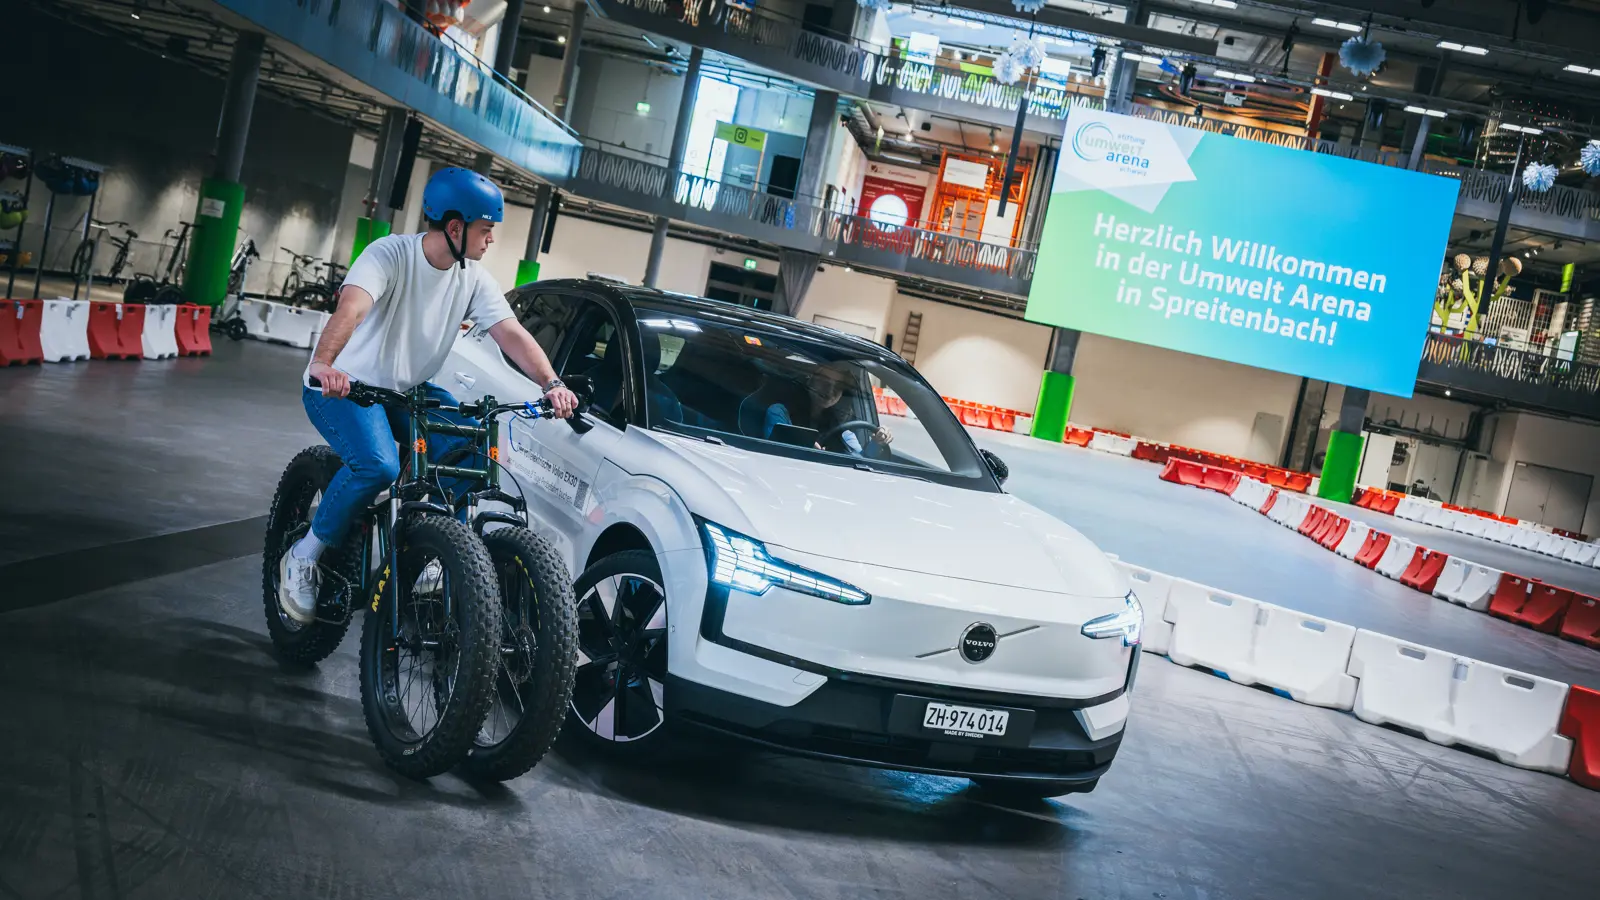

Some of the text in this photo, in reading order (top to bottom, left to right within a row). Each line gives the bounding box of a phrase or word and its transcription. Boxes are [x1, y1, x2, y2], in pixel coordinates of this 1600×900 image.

[1118, 134, 1145, 145] stiftung
[1106, 151, 1149, 168] arena
[1094, 213, 1387, 293] Herzlich Willkommen
[1095, 244, 1371, 322] in der Umwelt Arena
[1116, 278, 1338, 346] in Spreitenbach!
[552, 463, 564, 480] Volvo
[563, 471, 578, 487] EX30
[965, 639, 994, 648] VOLVO
[978, 713, 1004, 733] 014
